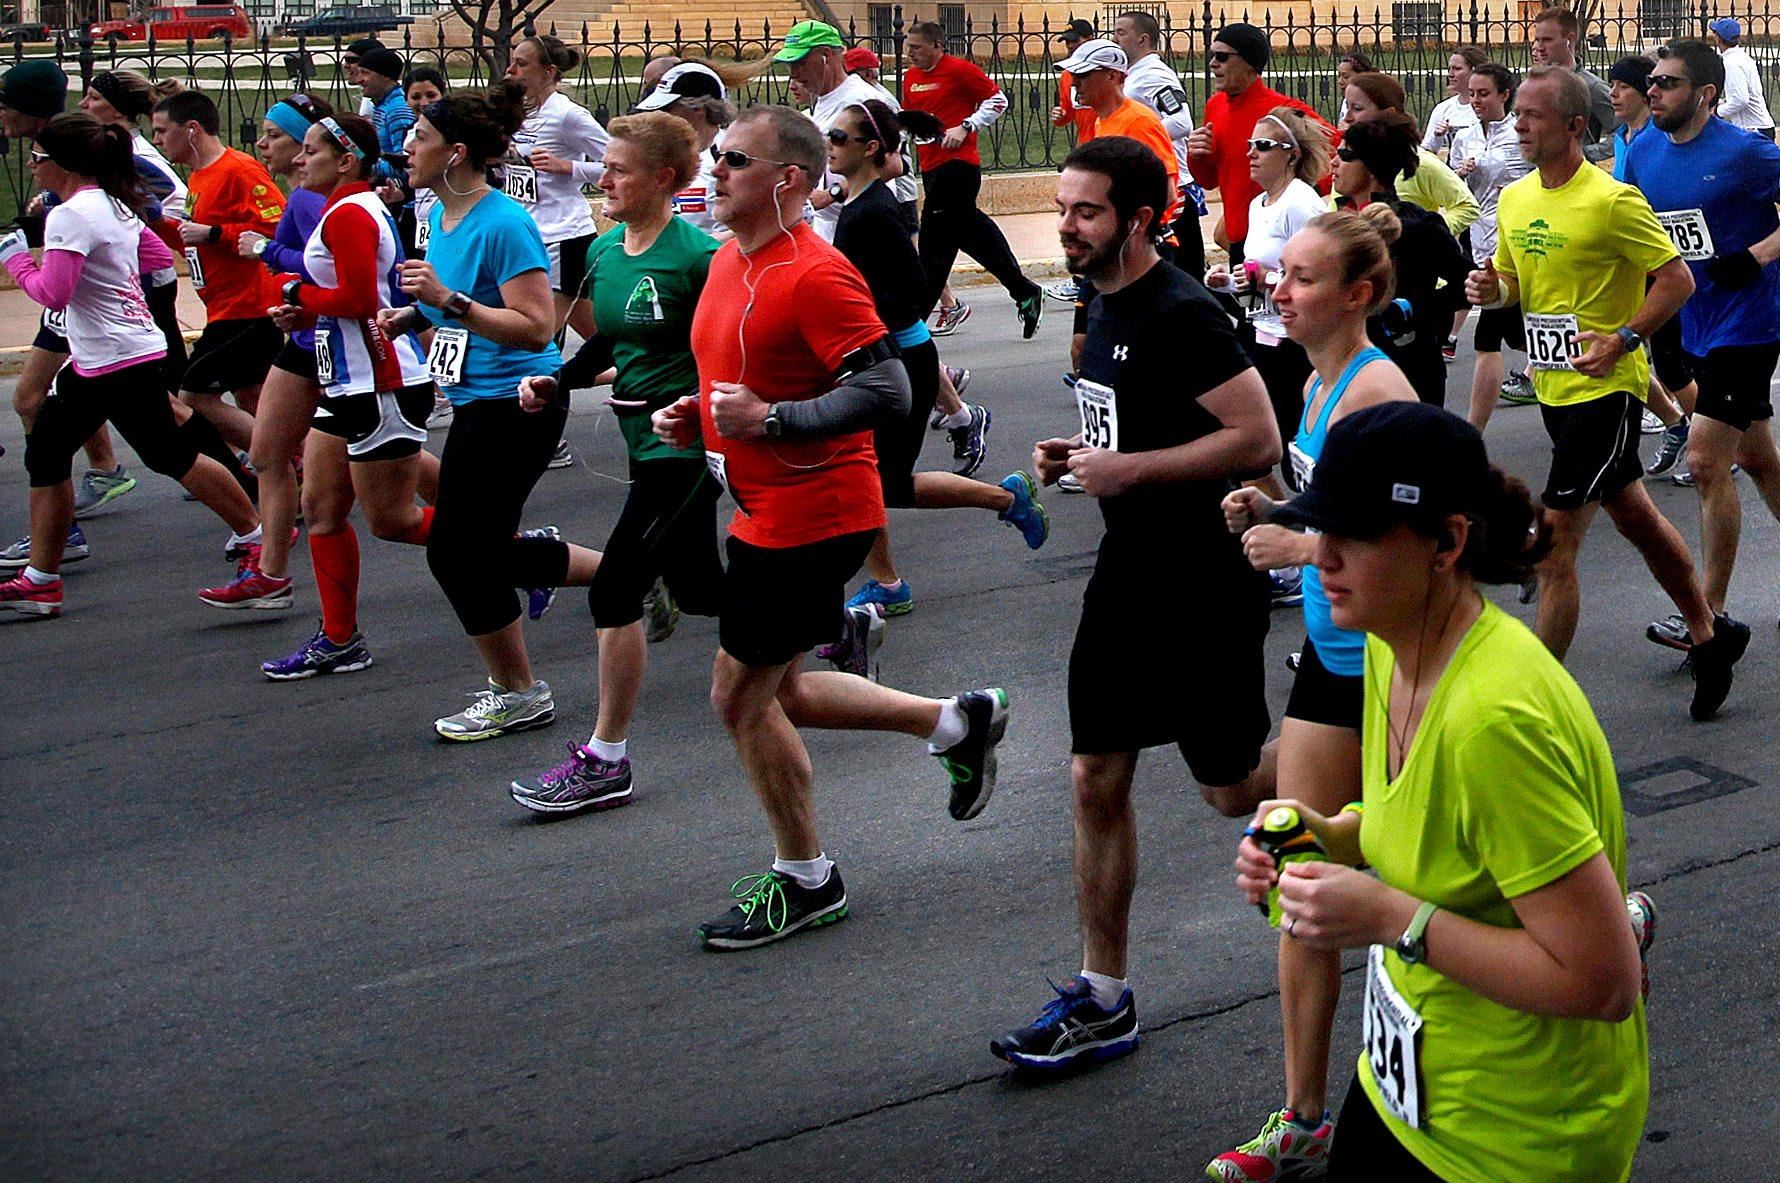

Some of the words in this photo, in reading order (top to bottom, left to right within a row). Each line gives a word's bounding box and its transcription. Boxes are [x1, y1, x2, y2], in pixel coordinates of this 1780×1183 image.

[508, 174, 534, 199] 1034
[431, 342, 458, 376] 242
[1527, 328, 1580, 362] 1626
